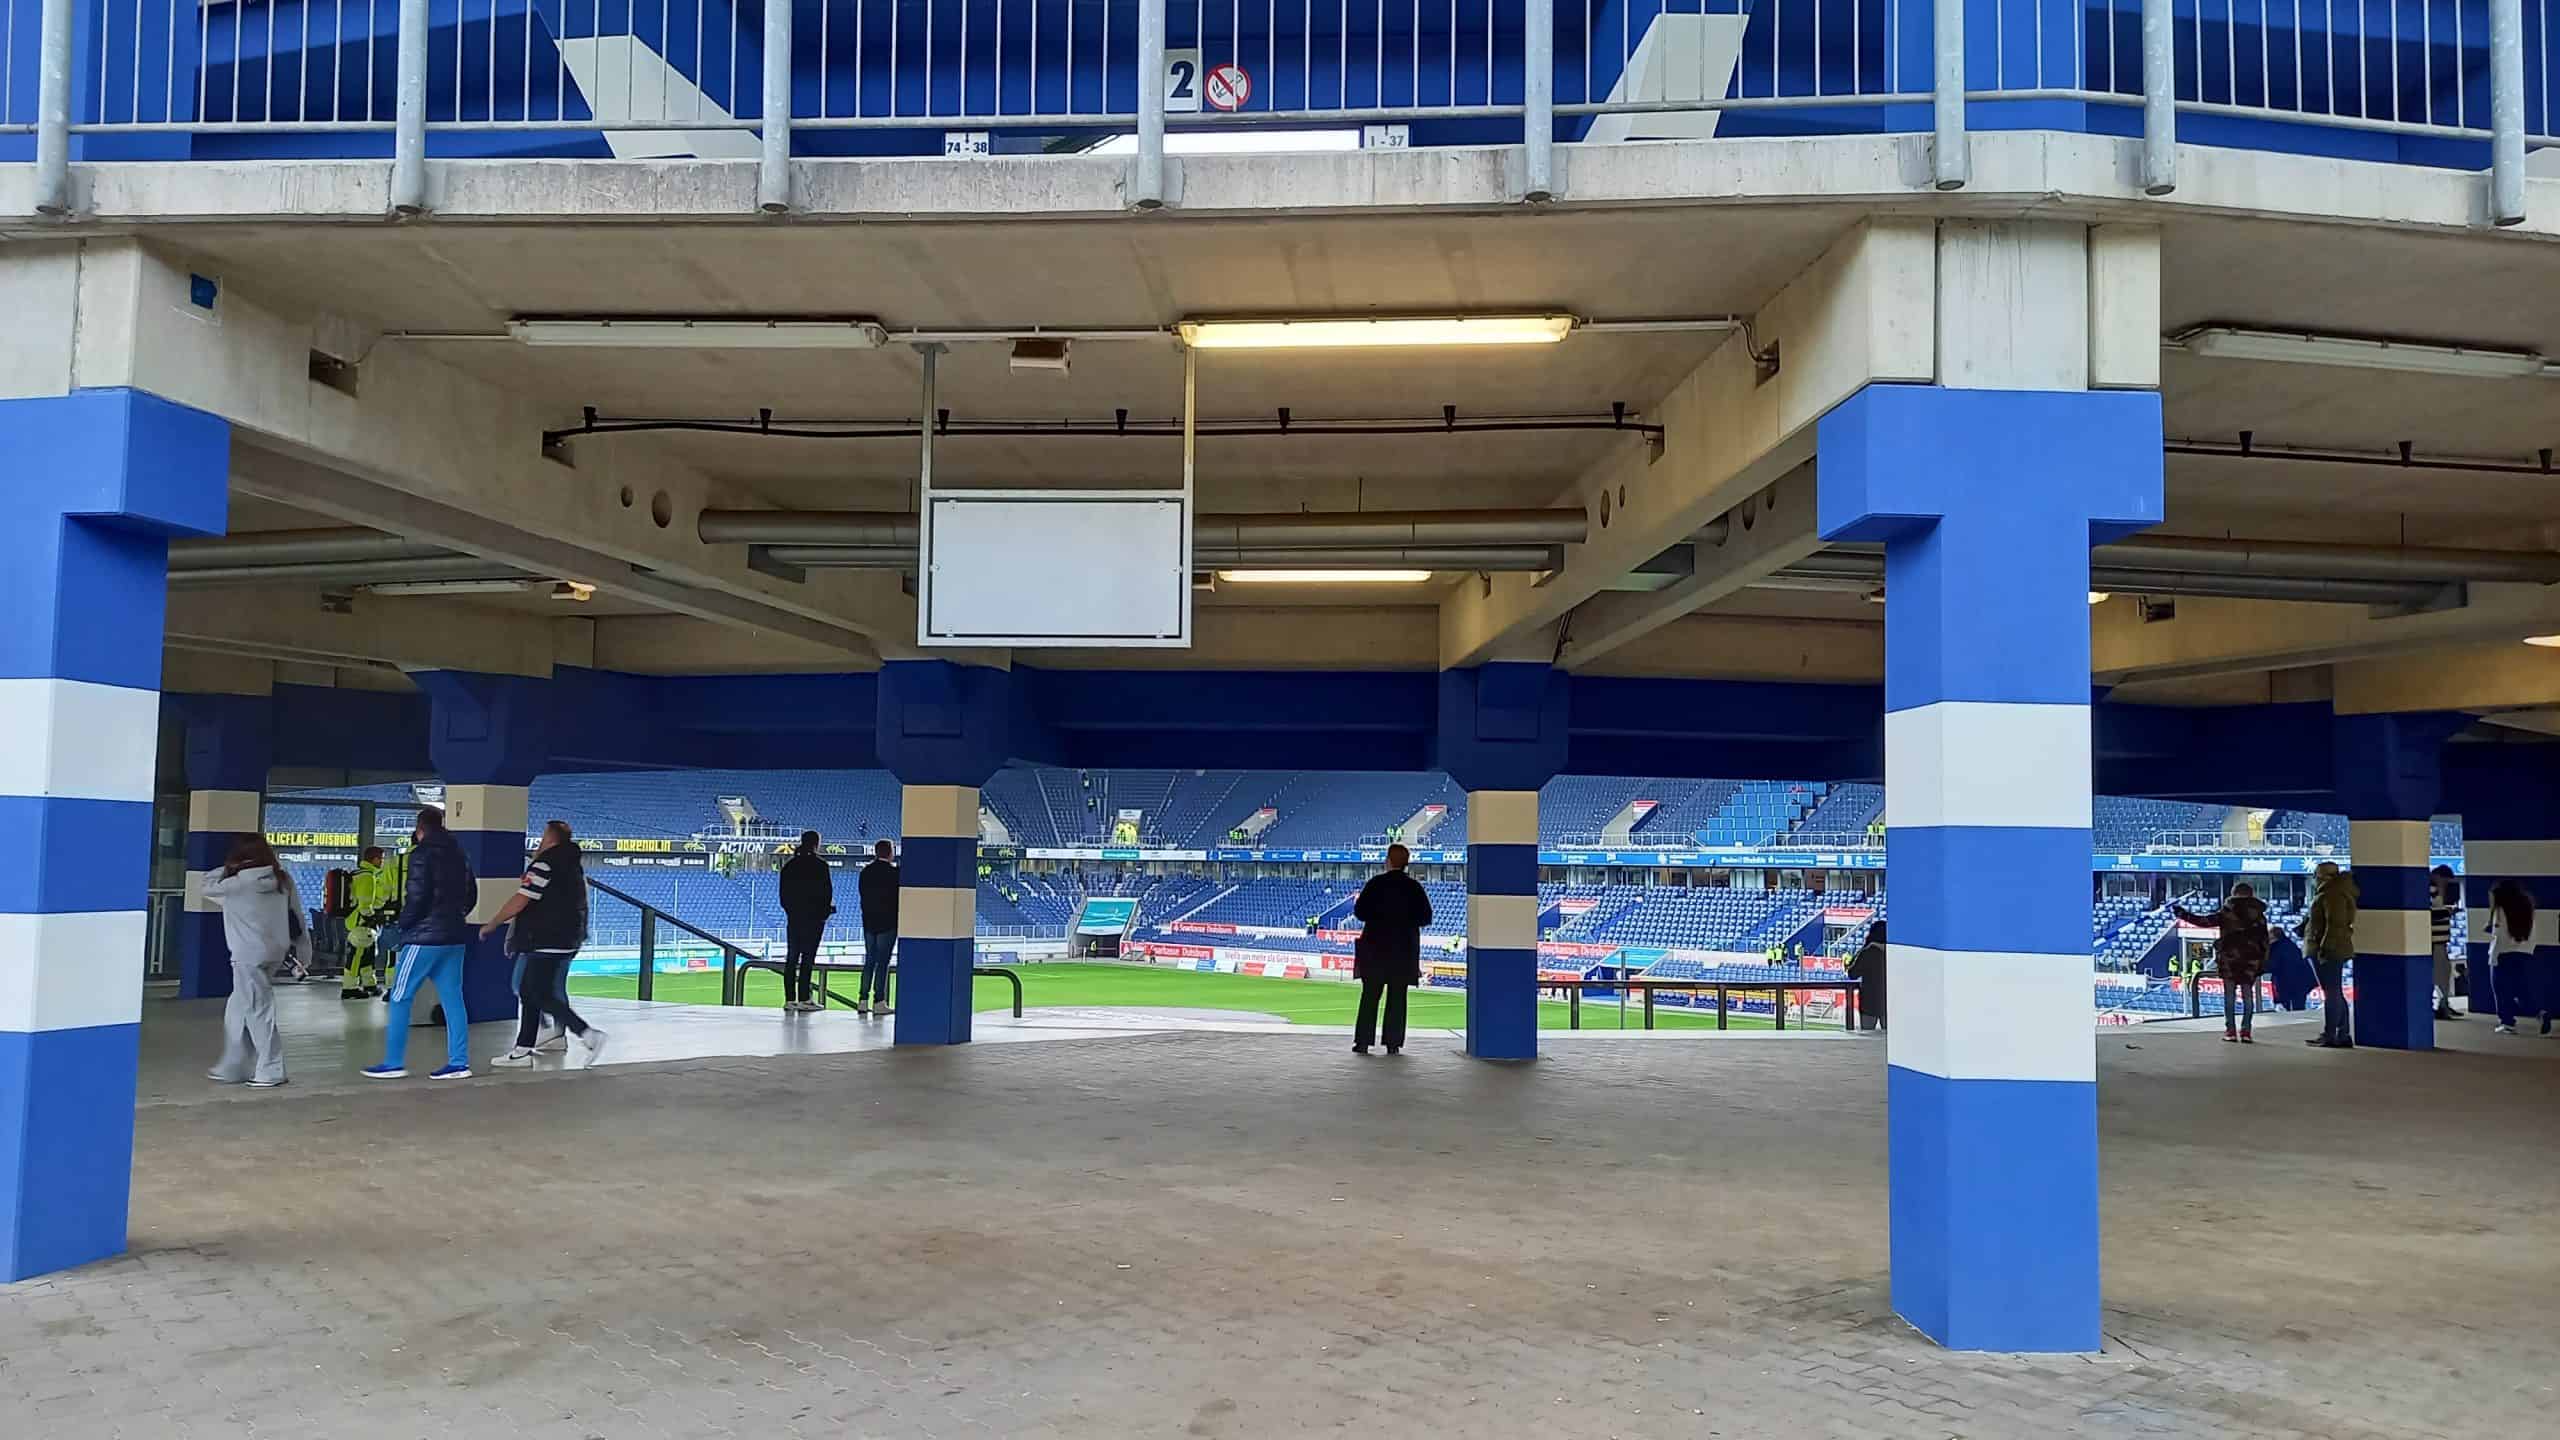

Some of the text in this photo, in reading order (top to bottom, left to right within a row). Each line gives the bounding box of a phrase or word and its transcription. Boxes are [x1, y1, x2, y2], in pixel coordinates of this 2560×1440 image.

[1170, 60, 1194, 98] 2
[1389, 135, 1404, 147] 37
[947, 142, 961, 154] 74
[973, 142, 987, 153] 38
[718, 842, 765, 853] ACTION
